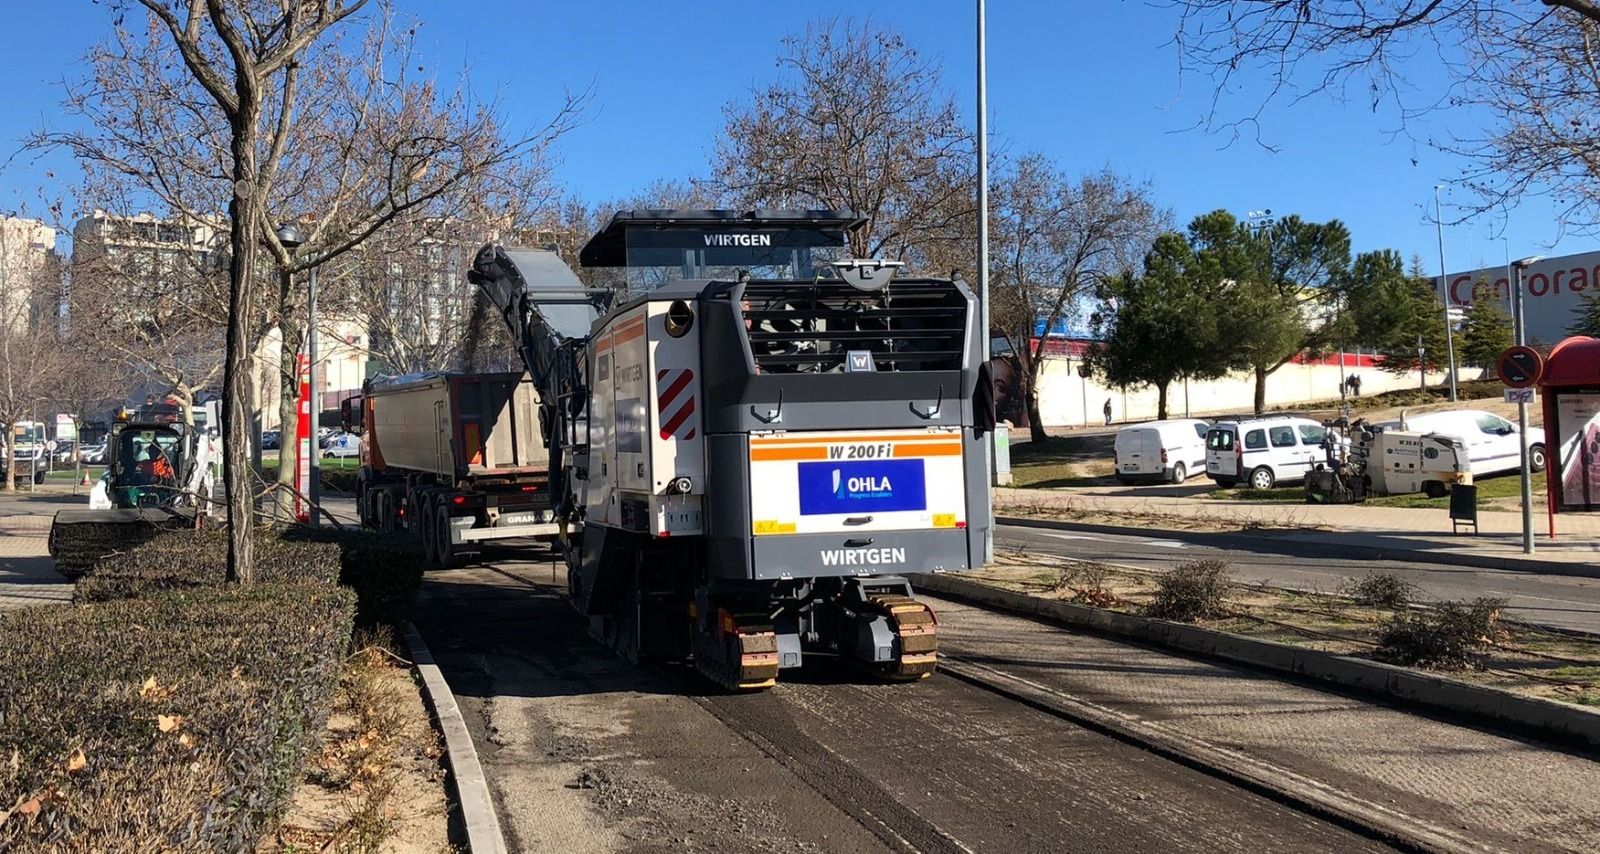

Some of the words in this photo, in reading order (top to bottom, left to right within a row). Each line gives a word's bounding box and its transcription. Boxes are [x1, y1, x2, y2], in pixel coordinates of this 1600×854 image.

[704, 234, 771, 246] WIRTGEN
[829, 446, 844, 459] W
[848, 476, 892, 492] OHLA
[820, 547, 906, 566] WIRTGEN
